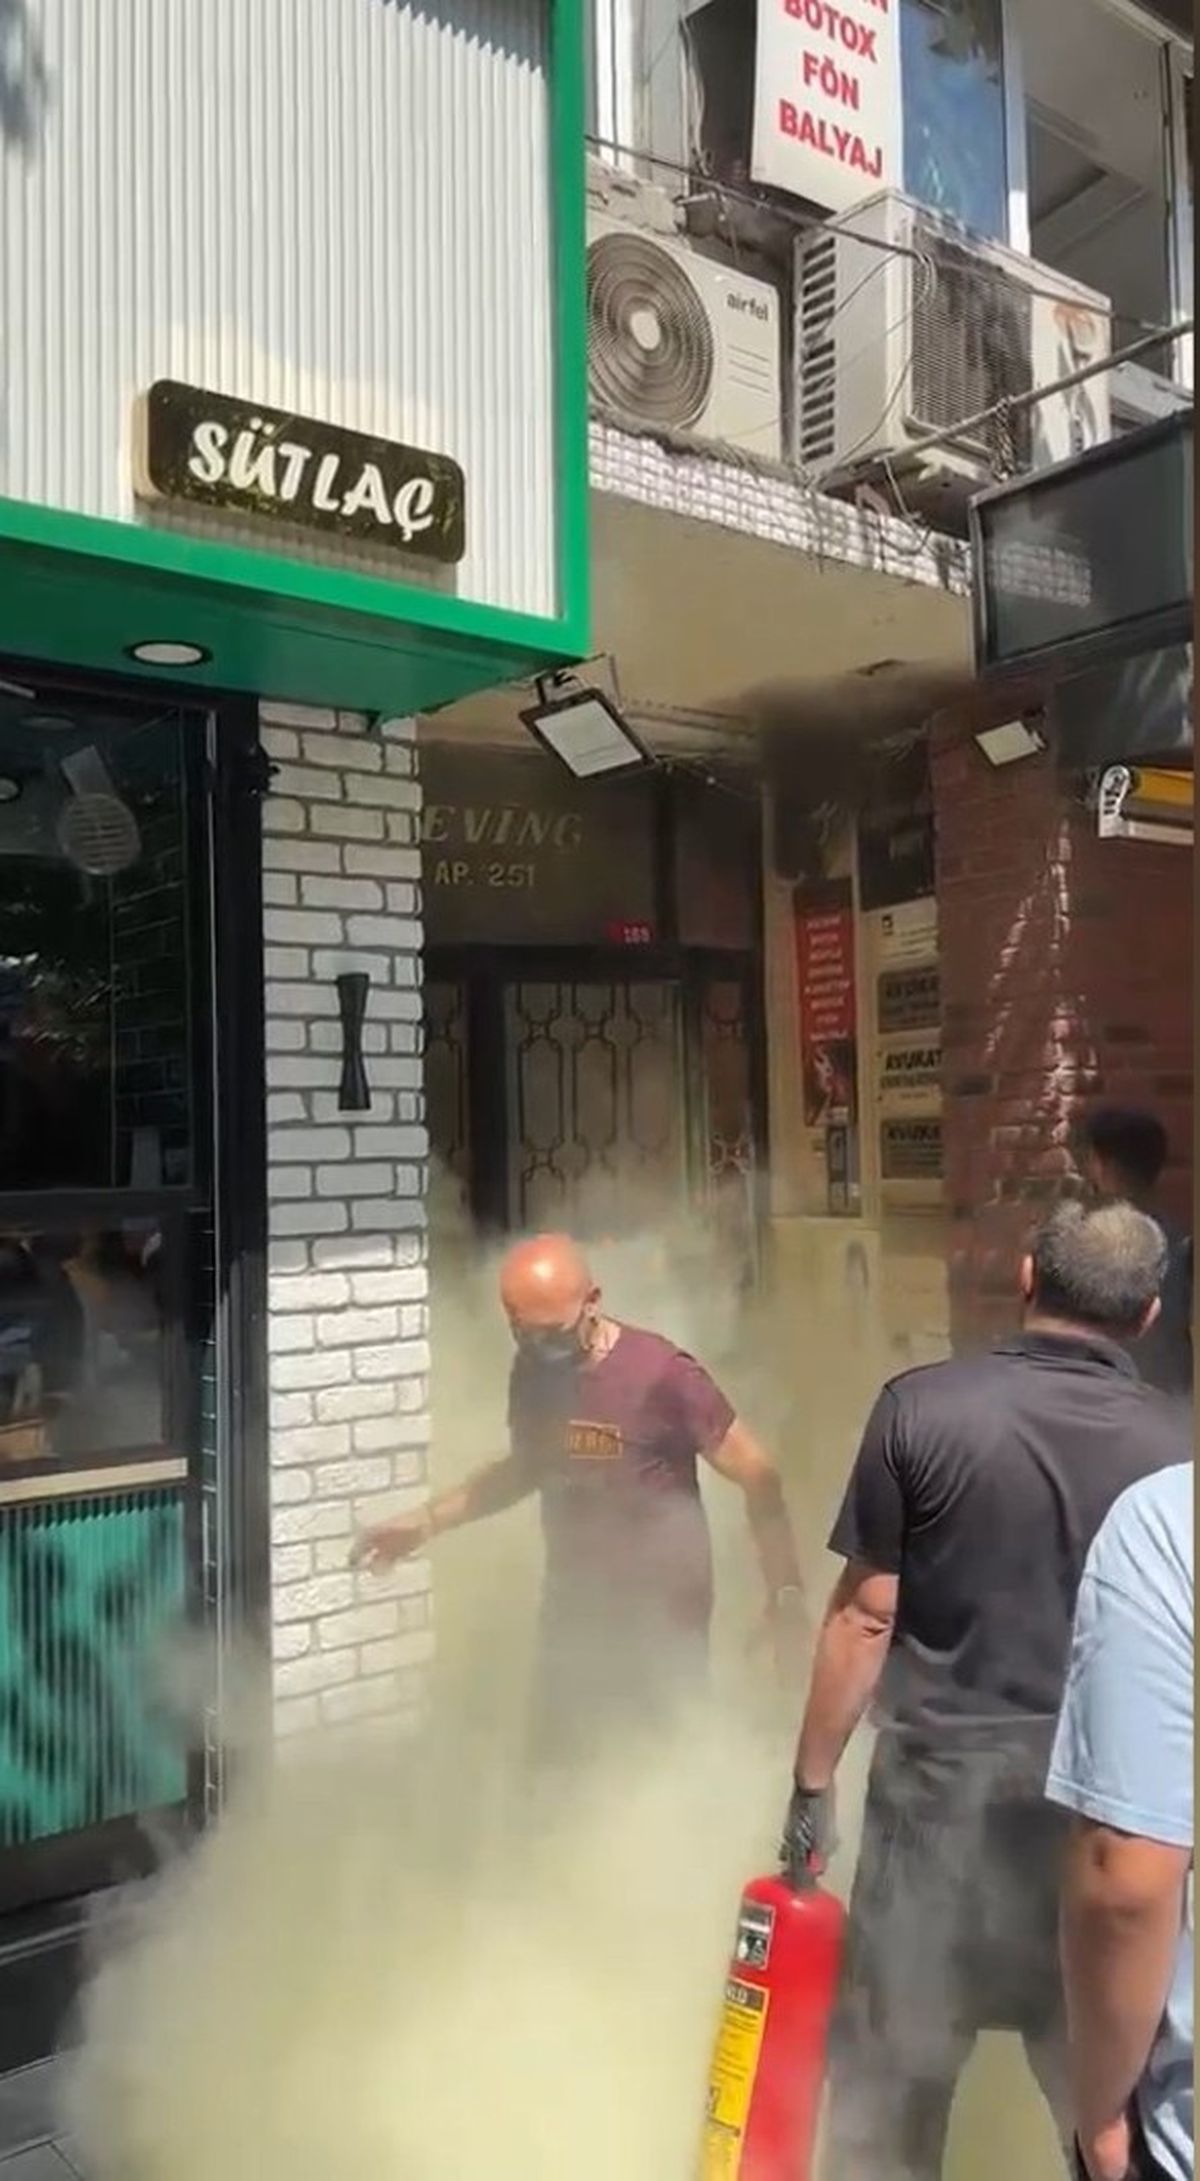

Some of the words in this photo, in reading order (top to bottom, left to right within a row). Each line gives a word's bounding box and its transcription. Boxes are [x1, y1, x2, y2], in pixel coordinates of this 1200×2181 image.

[803, 51, 860, 110] FÖN
[779, 99, 883, 179] BALYAJ
[726, 293, 769, 321] airfel
[188, 417, 435, 542] SÜTLAÇ
